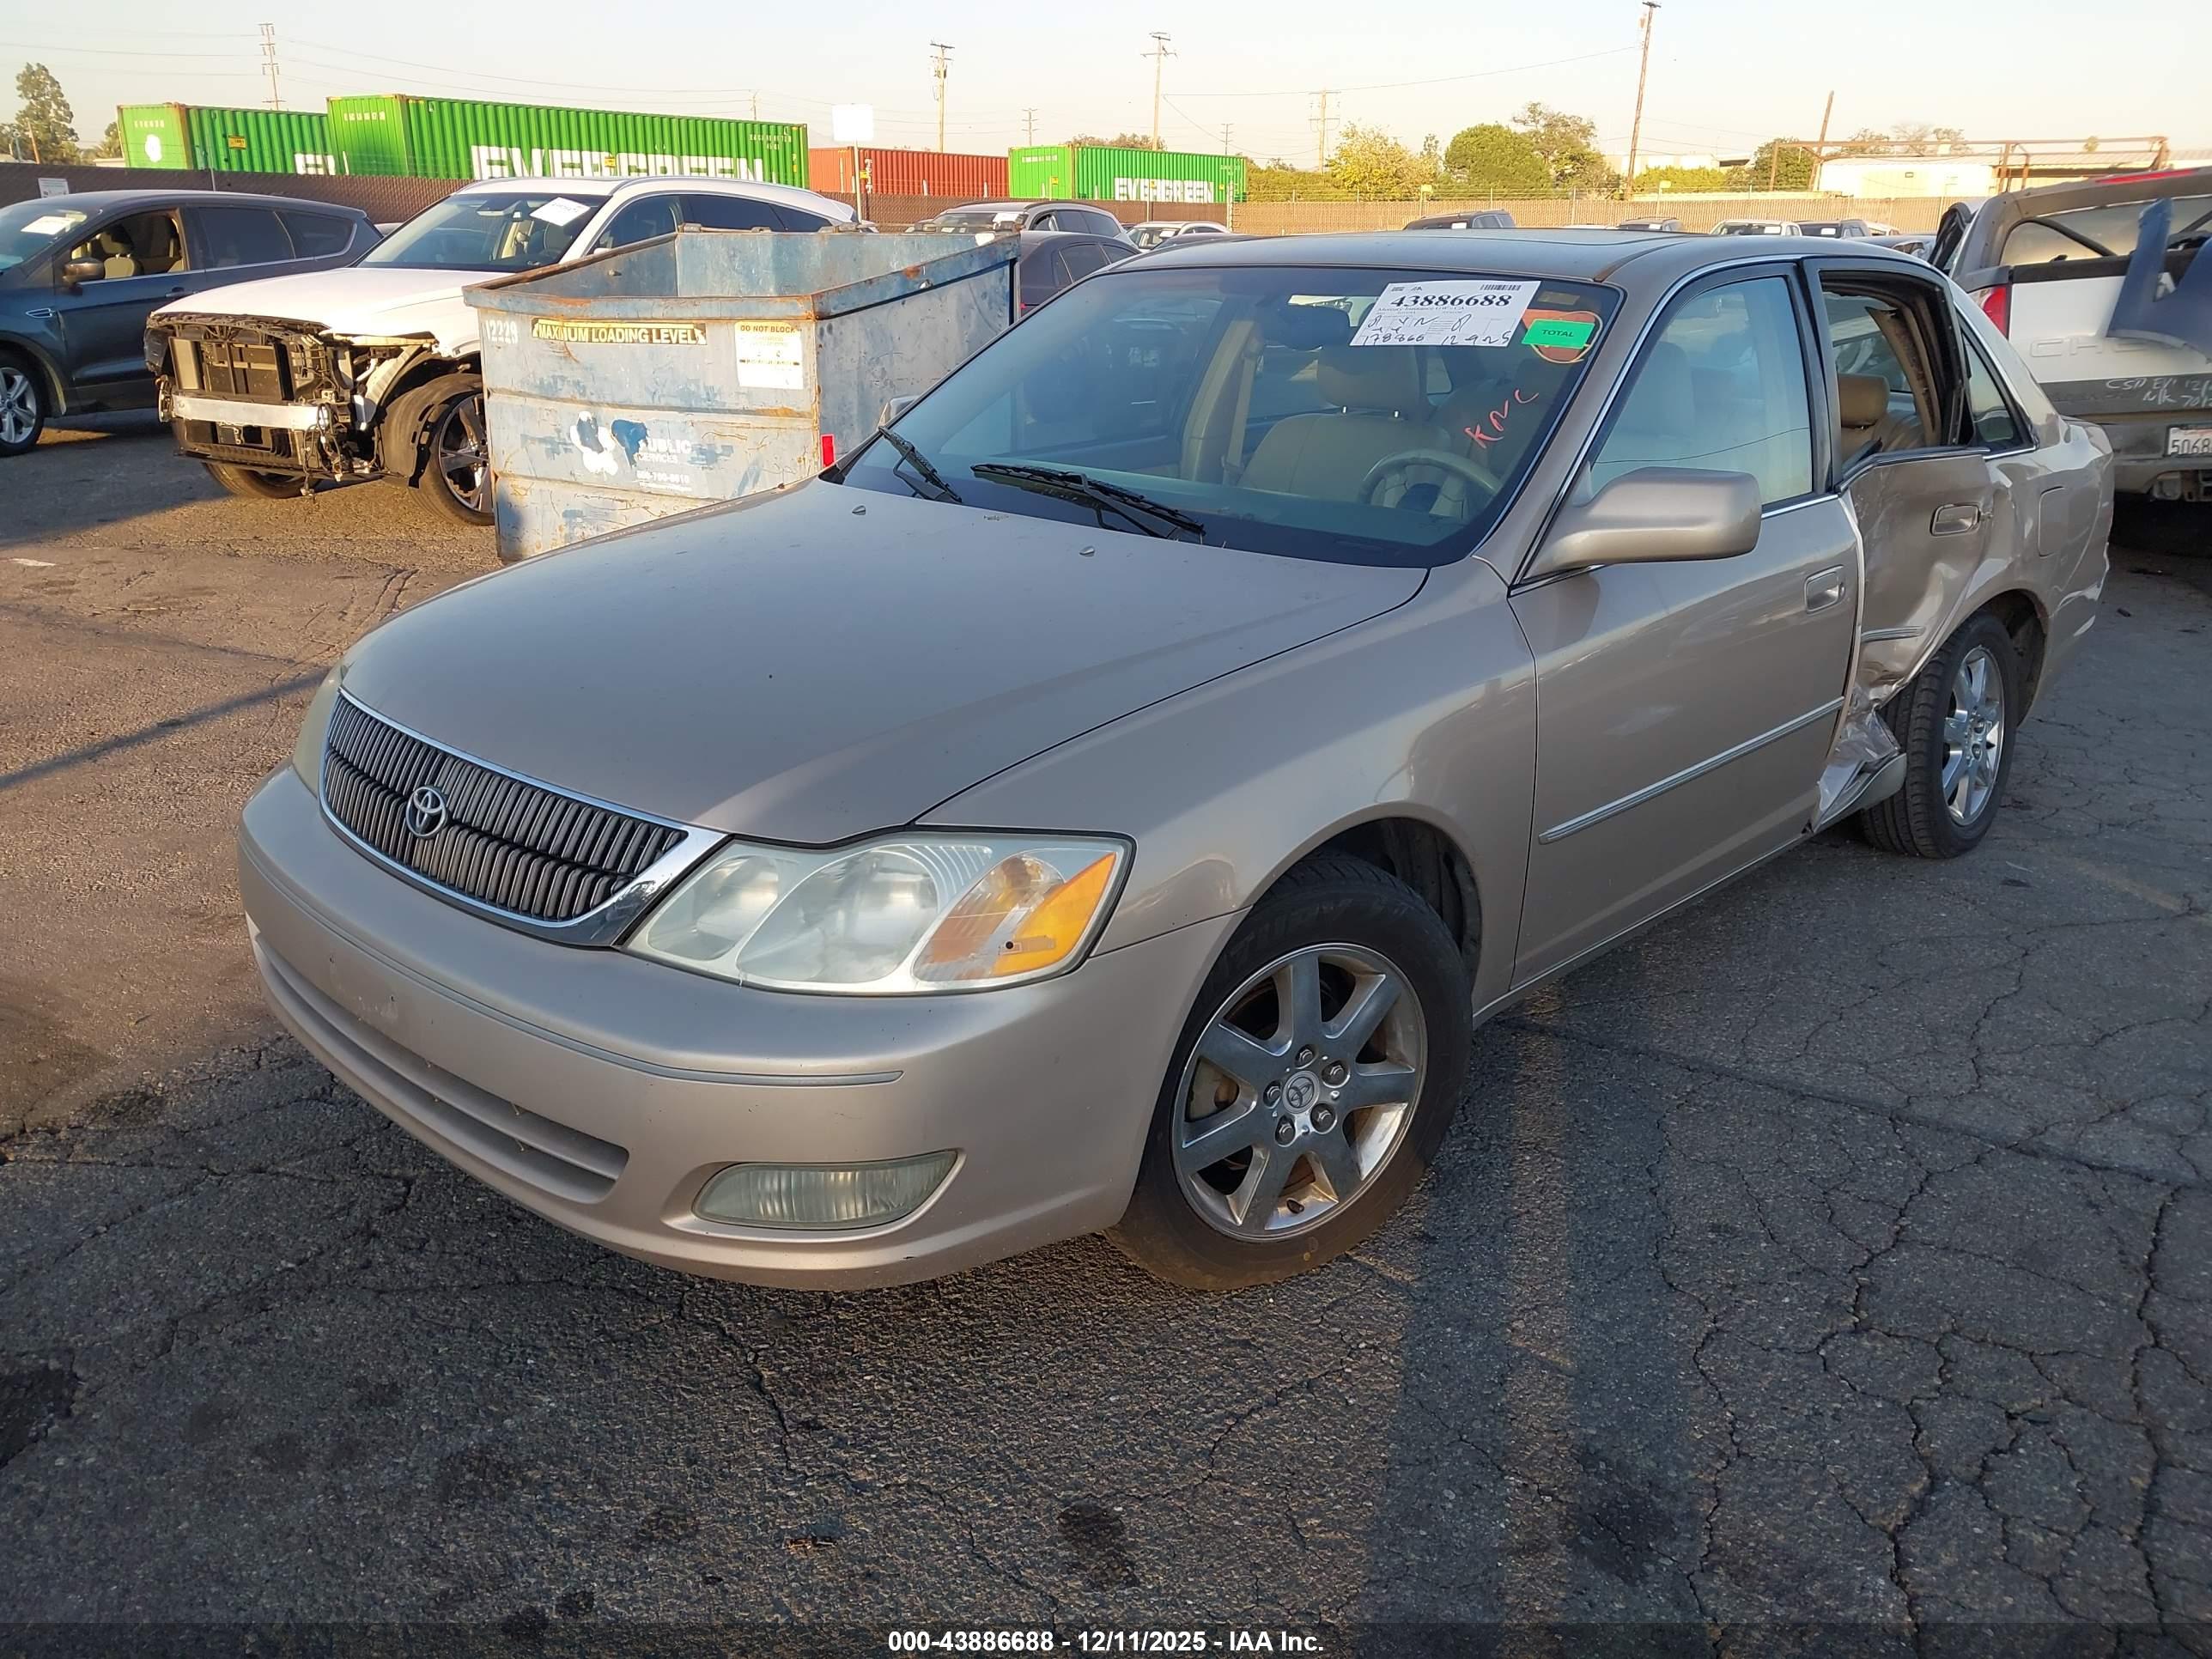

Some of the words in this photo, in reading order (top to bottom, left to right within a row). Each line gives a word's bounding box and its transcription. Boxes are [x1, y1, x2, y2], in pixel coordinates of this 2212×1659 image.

[1115, 177, 1214, 204] EVERGREEN
[1390, 295, 1512, 307] 43886688
[539, 325, 589, 343] MAXIMUM
[592, 328, 649, 343] LOADING
[652, 329, 697, 344] LEVEL
[1542, 329, 1574, 337] TOTAL
[2172, 438, 2212, 454] 5068
